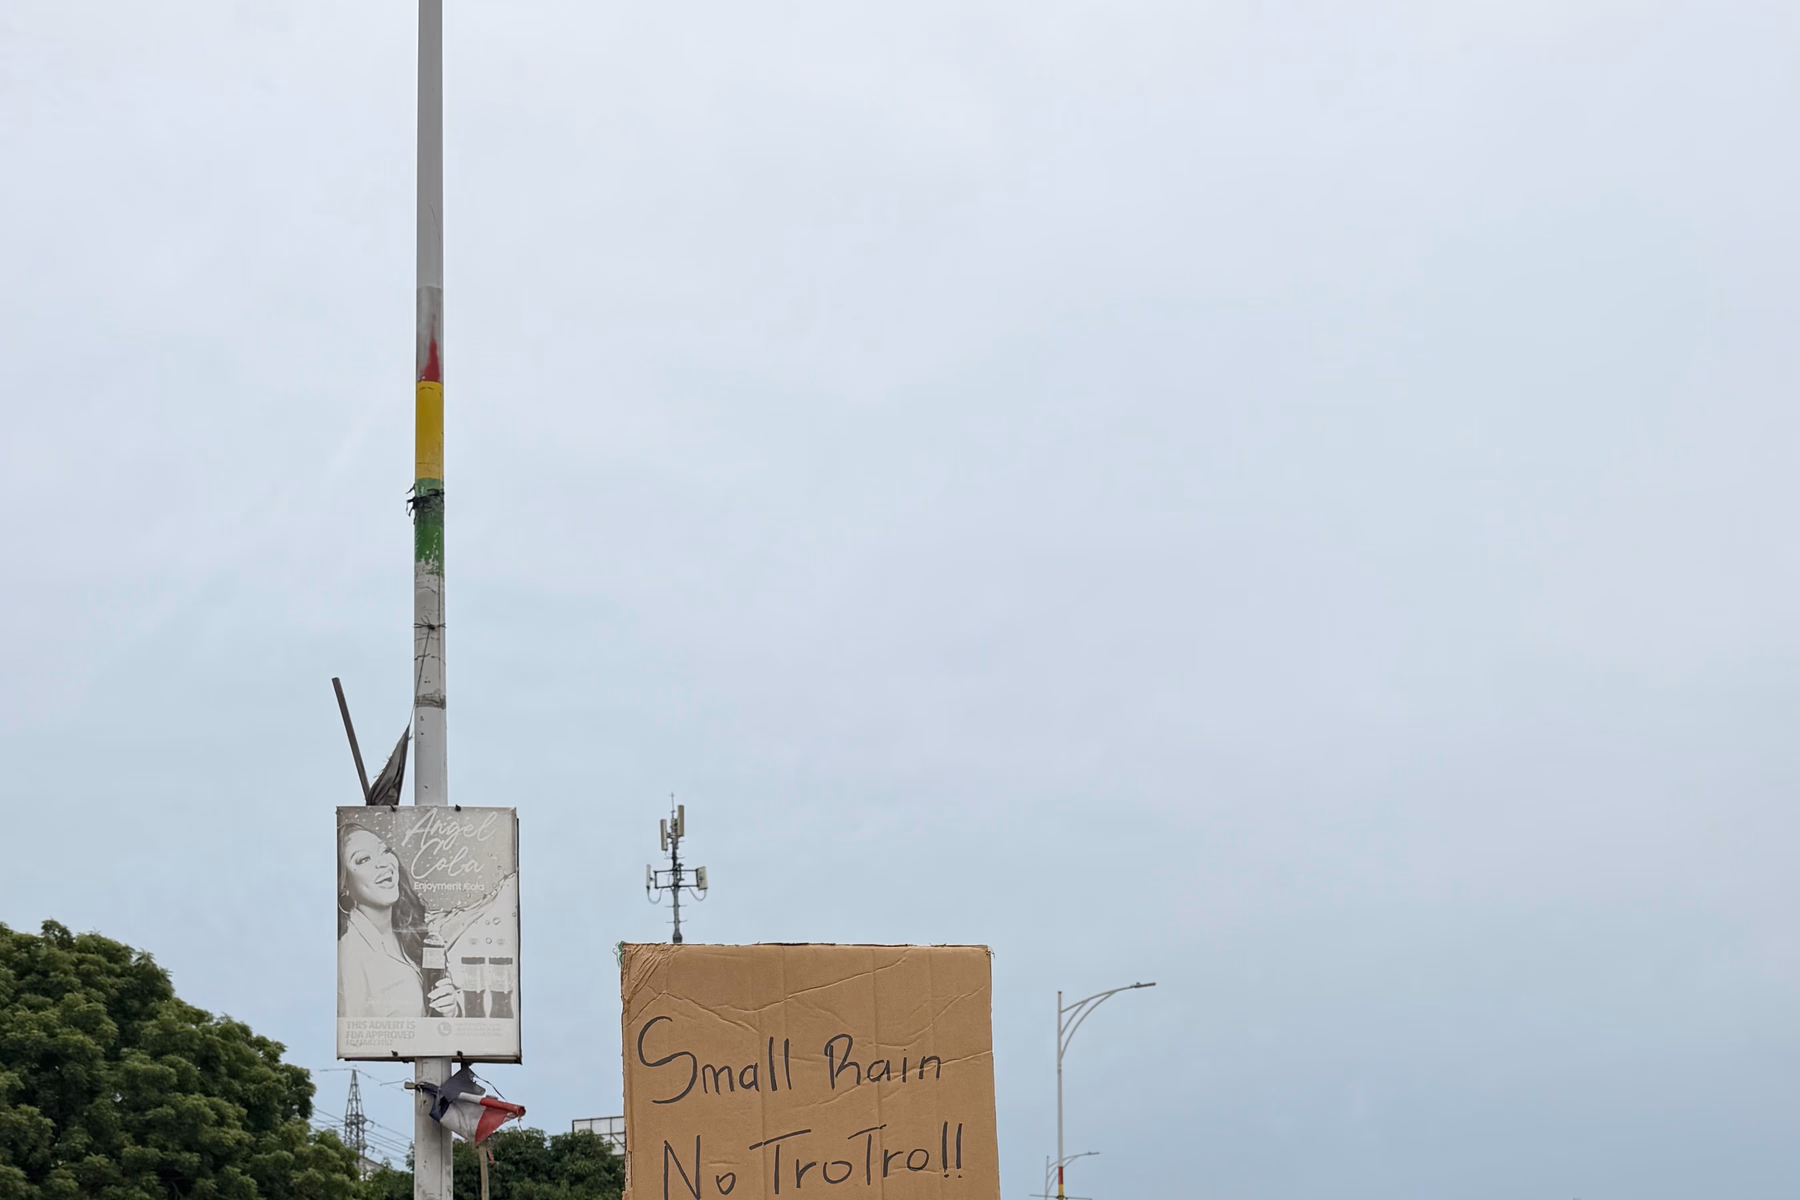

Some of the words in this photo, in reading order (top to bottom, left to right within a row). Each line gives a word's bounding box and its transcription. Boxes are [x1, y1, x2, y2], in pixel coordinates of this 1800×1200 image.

[401, 807, 497, 851] Angel
[411, 838, 485, 879] Cola
[413, 881, 461, 892] Enjoyment
[345, 1020, 367, 1029] THIS
[369, 1020, 405, 1029] ADVERT
[406, 1020, 416, 1029] IS
[345, 1031, 364, 1039] FDA
[366, 1031, 415, 1039] APPROVED
[637, 1015, 792, 1105] Small
[824, 1033, 942, 1091] Rain
